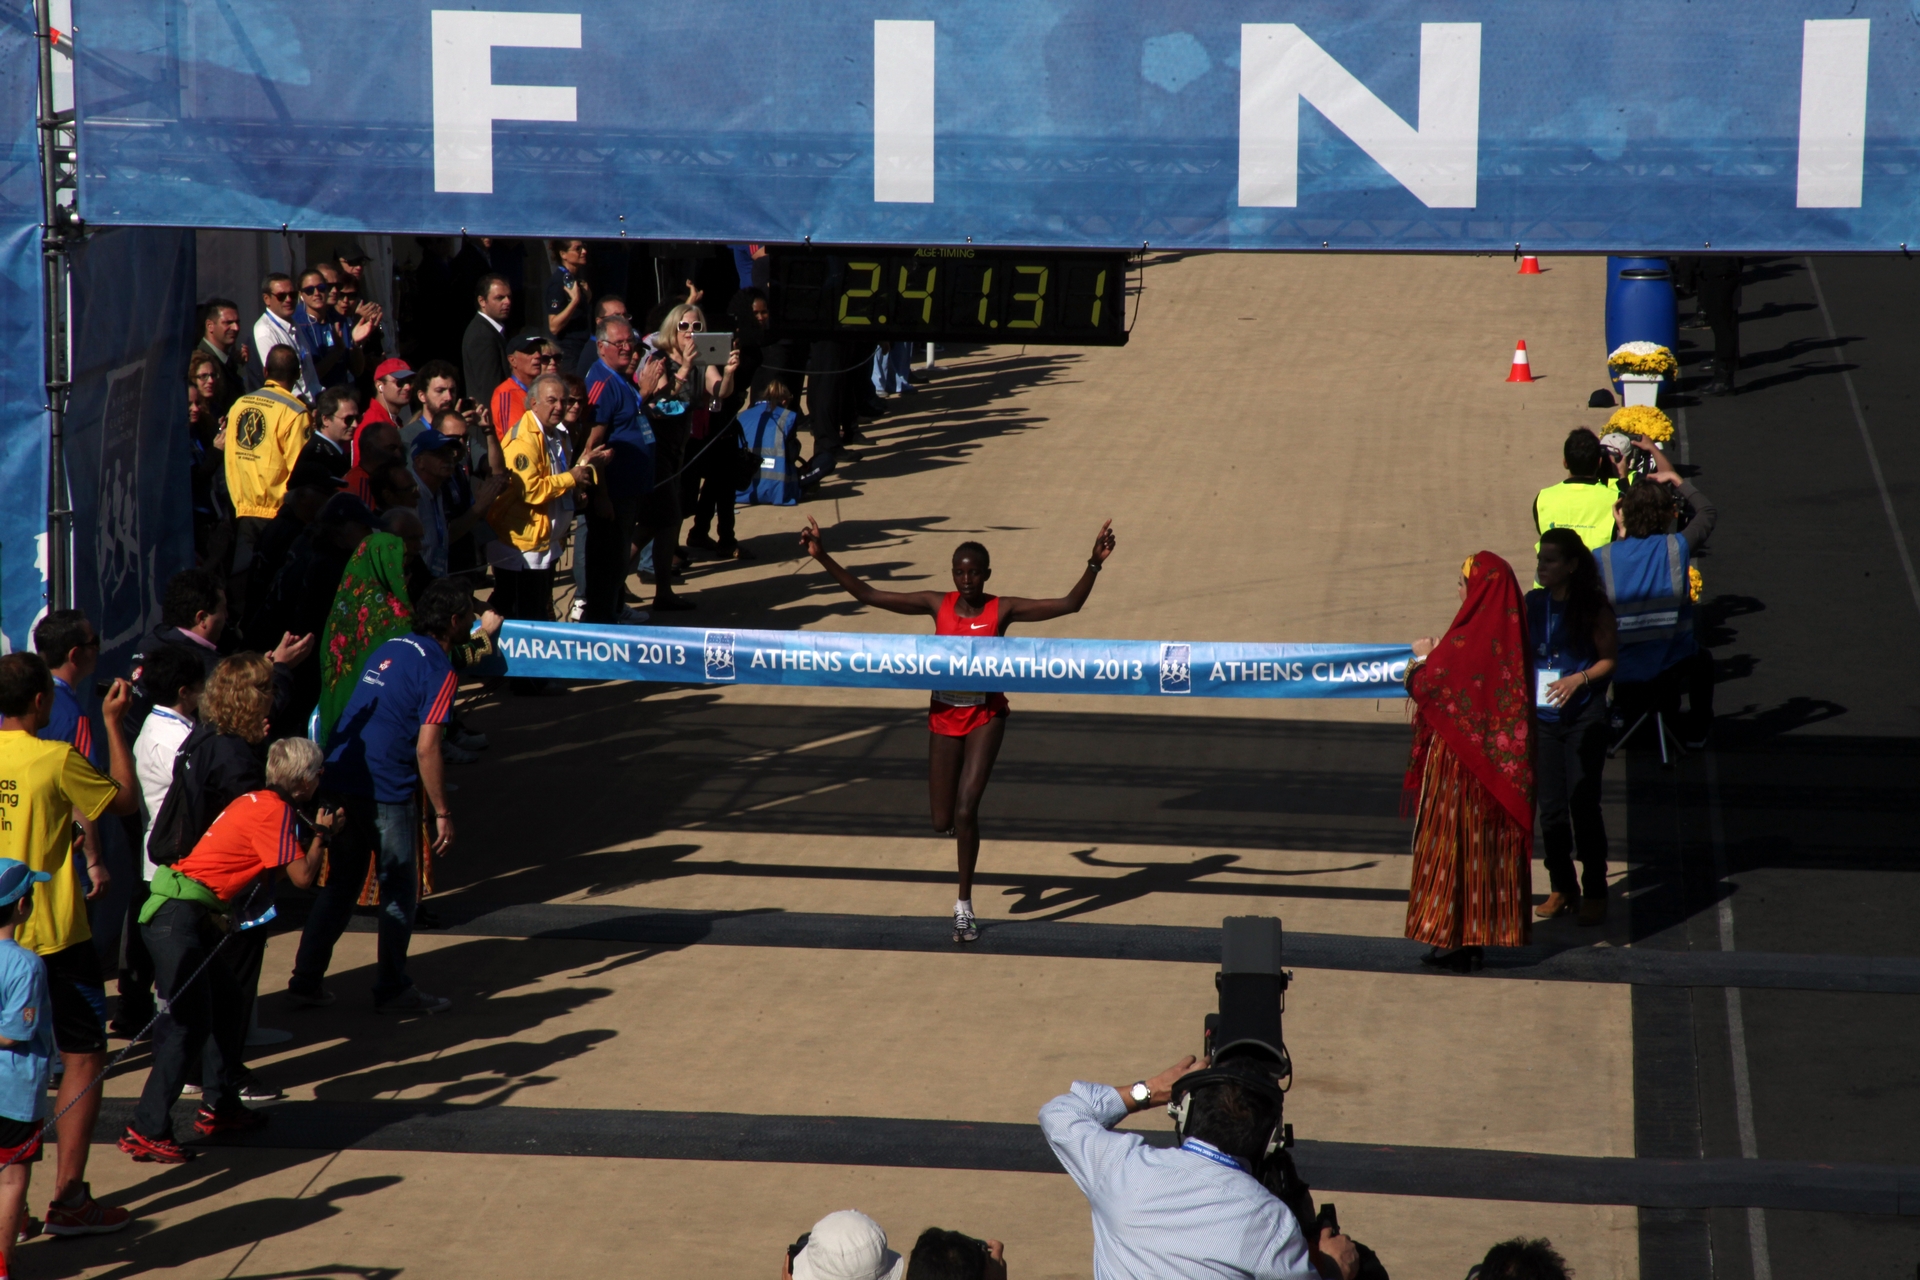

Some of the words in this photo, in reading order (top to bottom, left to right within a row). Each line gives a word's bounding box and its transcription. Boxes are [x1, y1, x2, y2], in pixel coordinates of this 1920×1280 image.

[498, 637, 630, 663] MARATHON
[637, 643, 686, 666] 2013
[750, 649, 842, 672] ATHENS
[849, 652, 942, 676] CLASSIC
[948, 655, 1087, 680] MARATHON
[1093, 658, 1143, 681] 2013
[1209, 661, 1303, 682] ATHENS
[1311, 661, 1406, 683] CLASSIC
